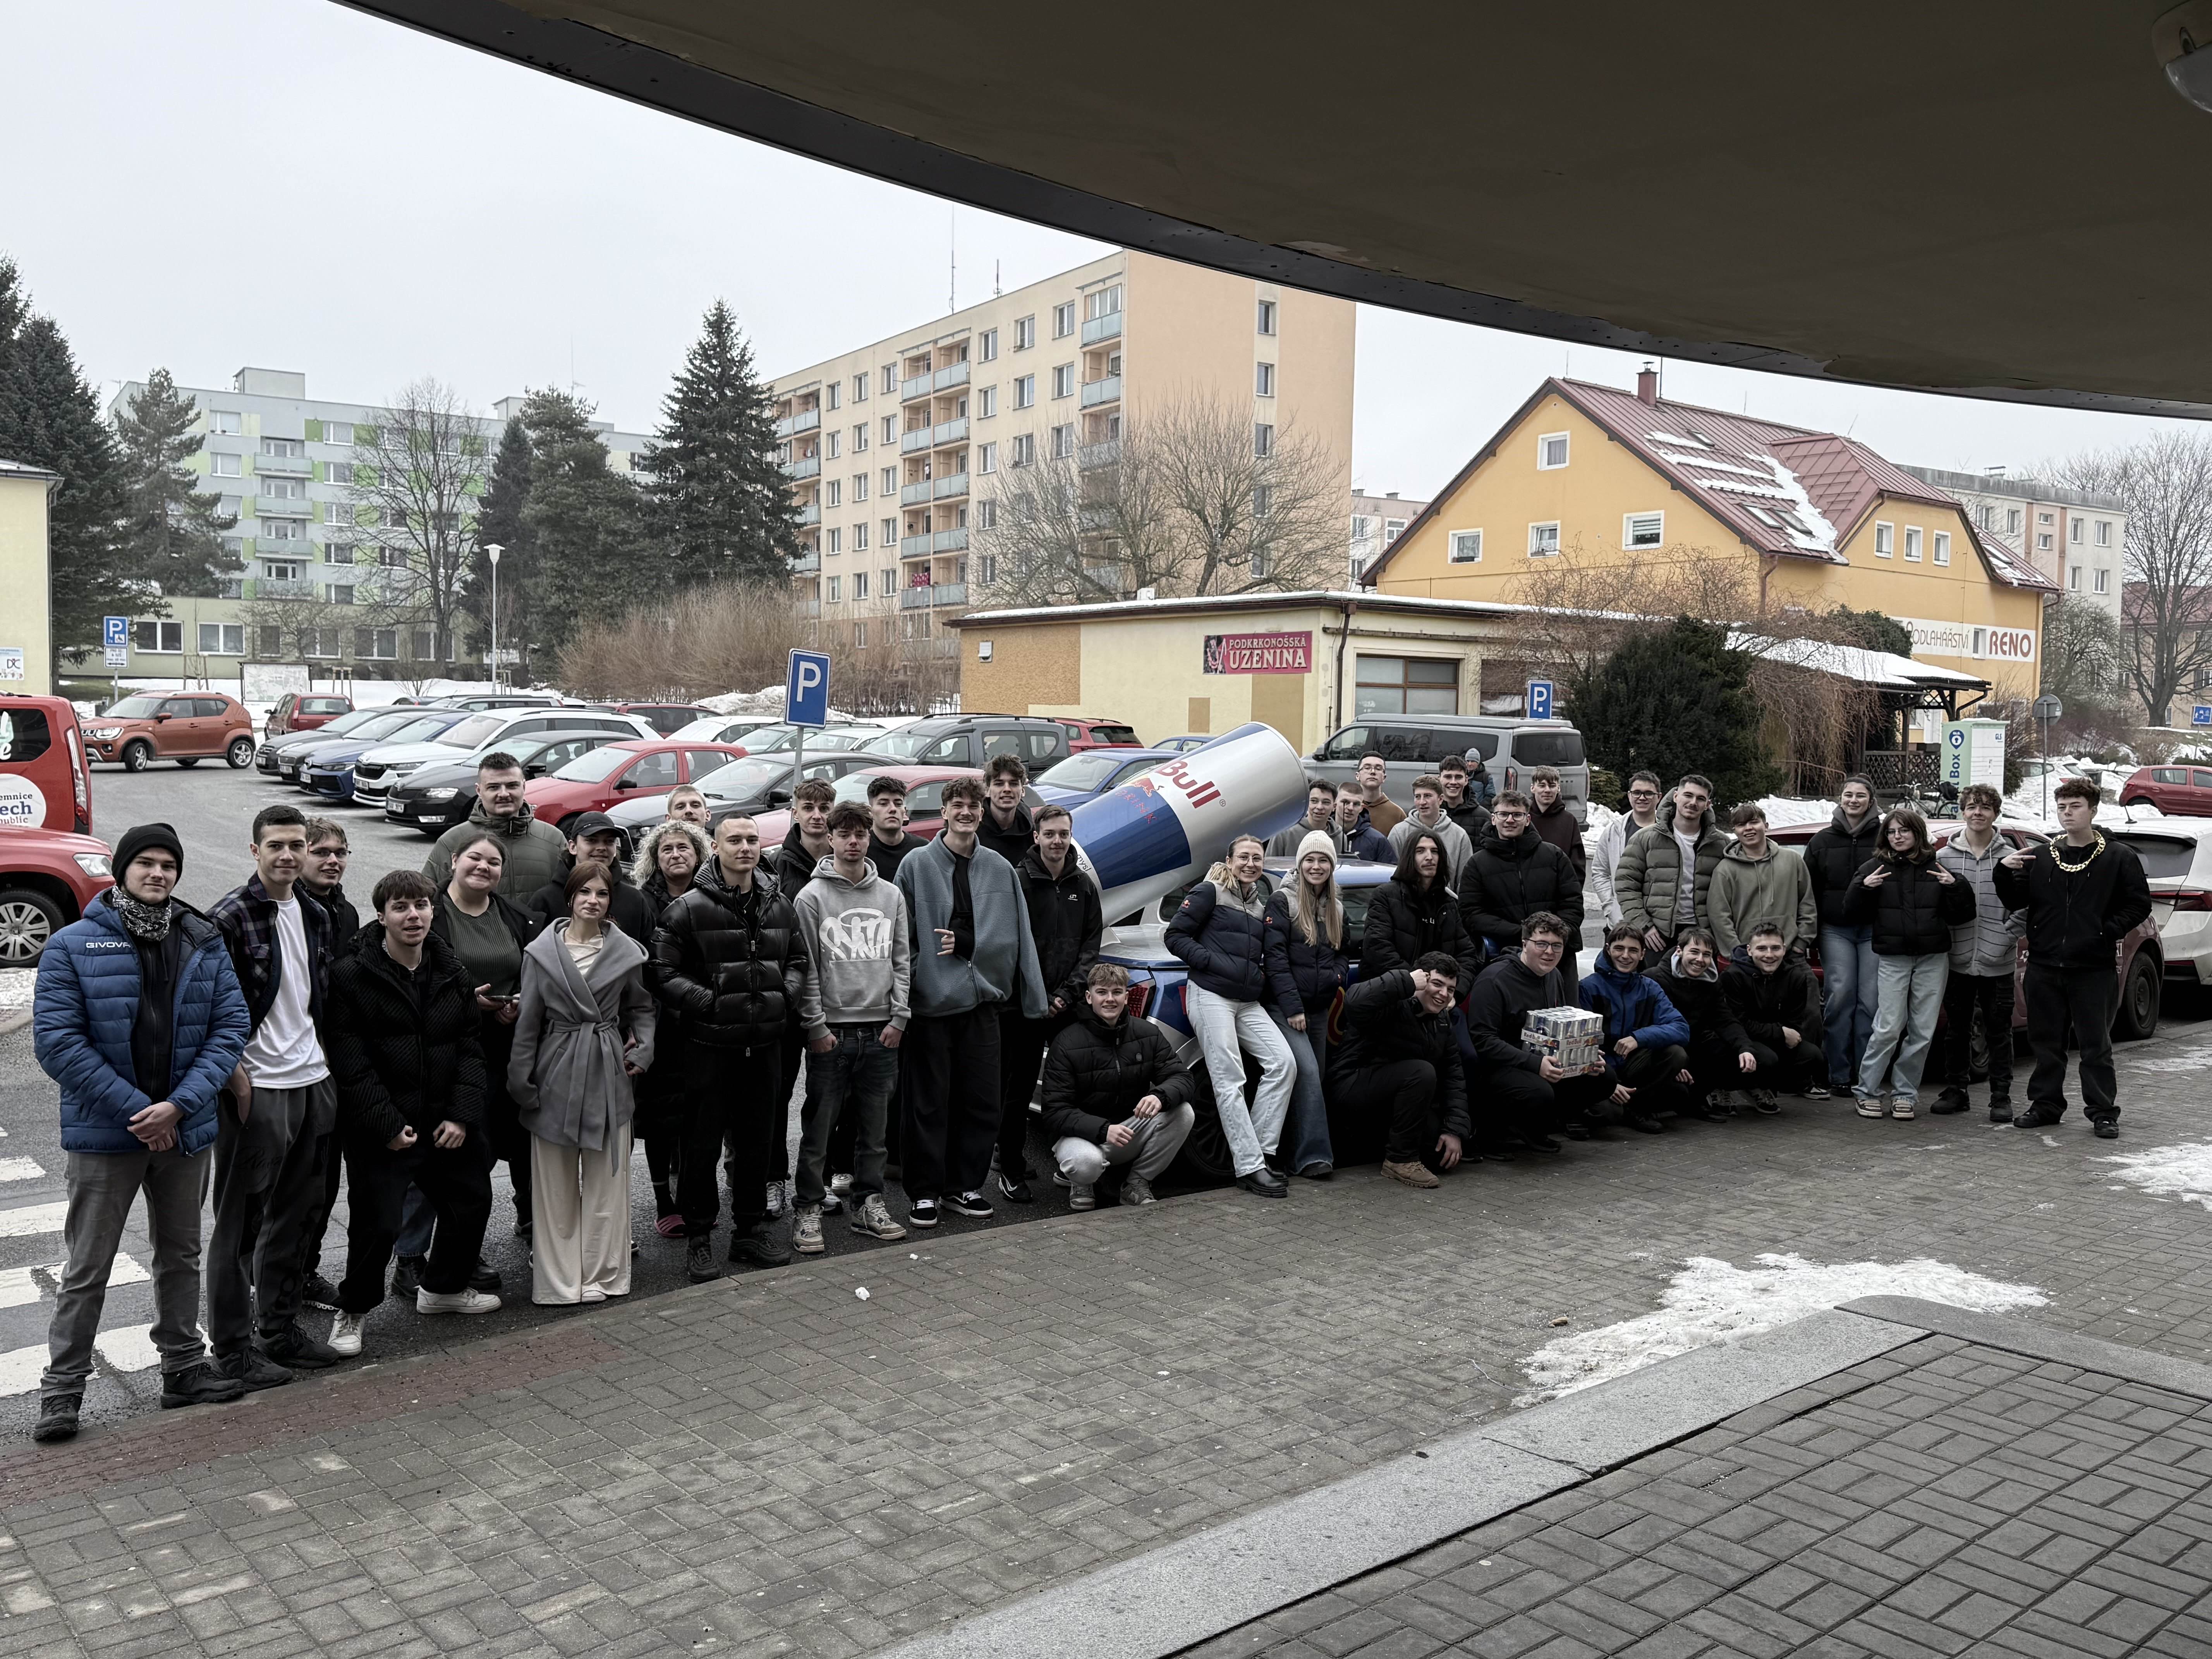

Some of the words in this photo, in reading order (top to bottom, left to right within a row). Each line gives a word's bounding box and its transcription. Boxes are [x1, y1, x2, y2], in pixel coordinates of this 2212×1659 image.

[109, 620, 123, 637] P
[1228, 635, 1307, 650] PODKRKONOŠSKÁ
[1989, 630, 2032, 658] RENO
[1229, 649, 1307, 669] UZENINA
[797, 661, 821, 702] P
[1533, 687, 1547, 710] P
[1949, 754, 1960, 778] Box
[1154, 760, 1221, 809] Bull
